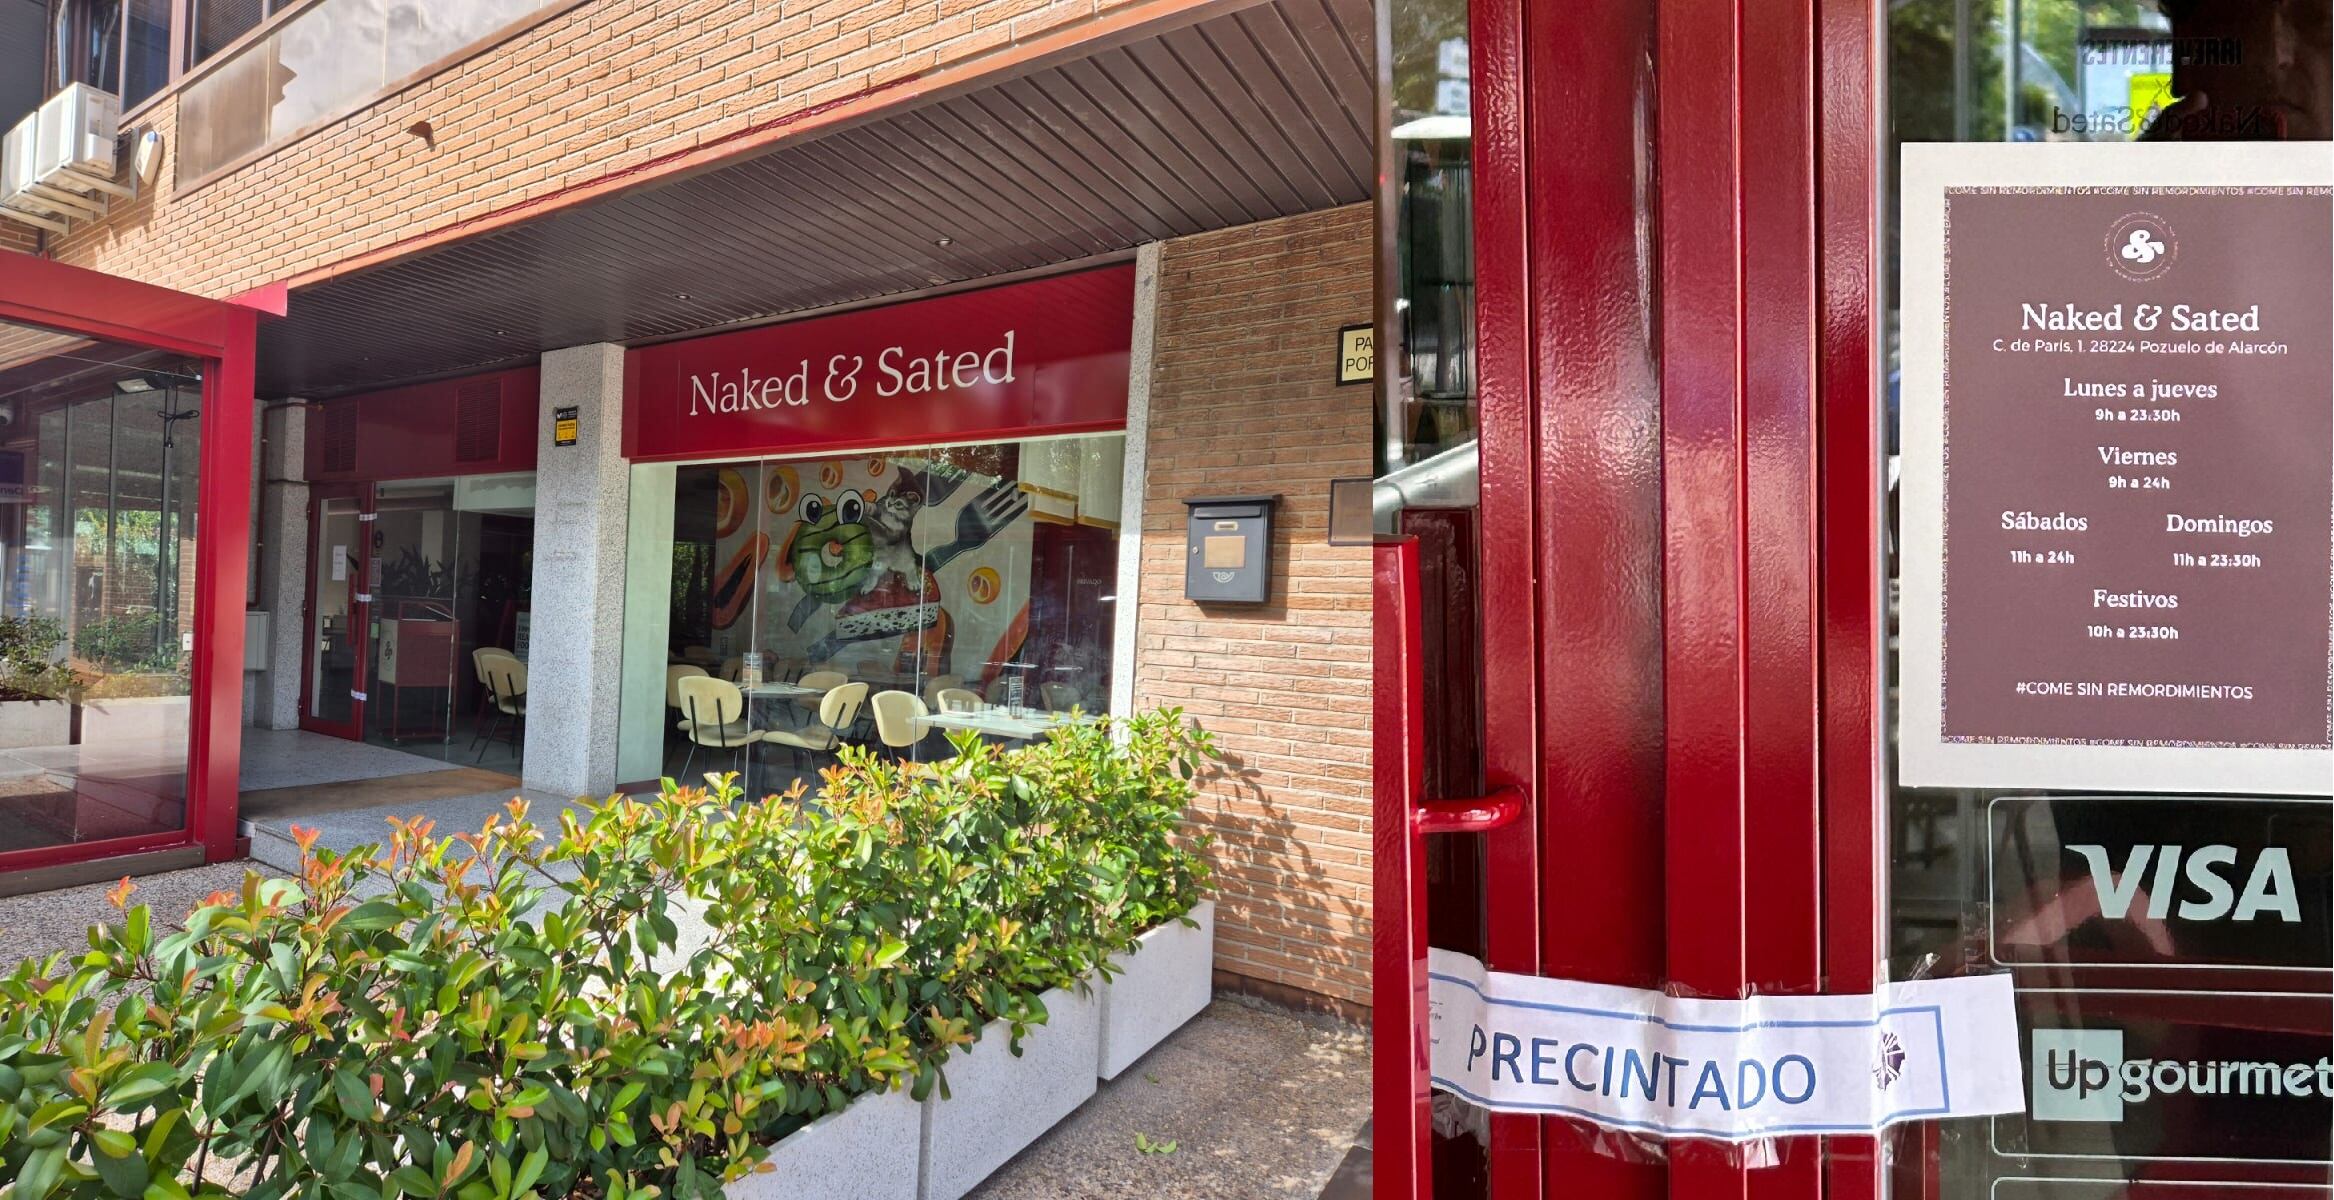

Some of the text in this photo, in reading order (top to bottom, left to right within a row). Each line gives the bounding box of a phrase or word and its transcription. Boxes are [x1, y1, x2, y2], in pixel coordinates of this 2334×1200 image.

[2022, 303, 2260, 332] Naked & Sated
[1993, 339, 2007, 352] C.
[2010, 339, 2031, 352] de
[2089, 340, 2135, 353] 28224
[2140, 340, 2201, 354] Pozuelo
[2205, 340, 2225, 354] de
[2228, 341, 2288, 355] Alarcón
[690, 329, 1016, 416] Naked & Sated
[2064, 377, 2218, 402] Lunes a jueves
[2095, 408, 2114, 421] 9h
[2117, 411, 2127, 421] a
[2098, 446, 2178, 466] Viernes
[2108, 476, 2170, 489] 9h a 24h
[2001, 511, 2088, 531] Sábados
[2166, 514, 2273, 537] Domingos
[2011, 550, 2075, 564] 11h a 24h
[2173, 553, 2195, 567] 11h
[2197, 556, 2207, 567] a
[2093, 589, 2178, 609] Festivos
[2087, 625, 2113, 638] 10h
[2116, 628, 2125, 638] a
[2015, 681, 2254, 700] #COME SIN REMORDIMIENTOS
[2064, 844, 2302, 922] VISA
[1467, 1023, 1817, 1111] PRECINTADO
